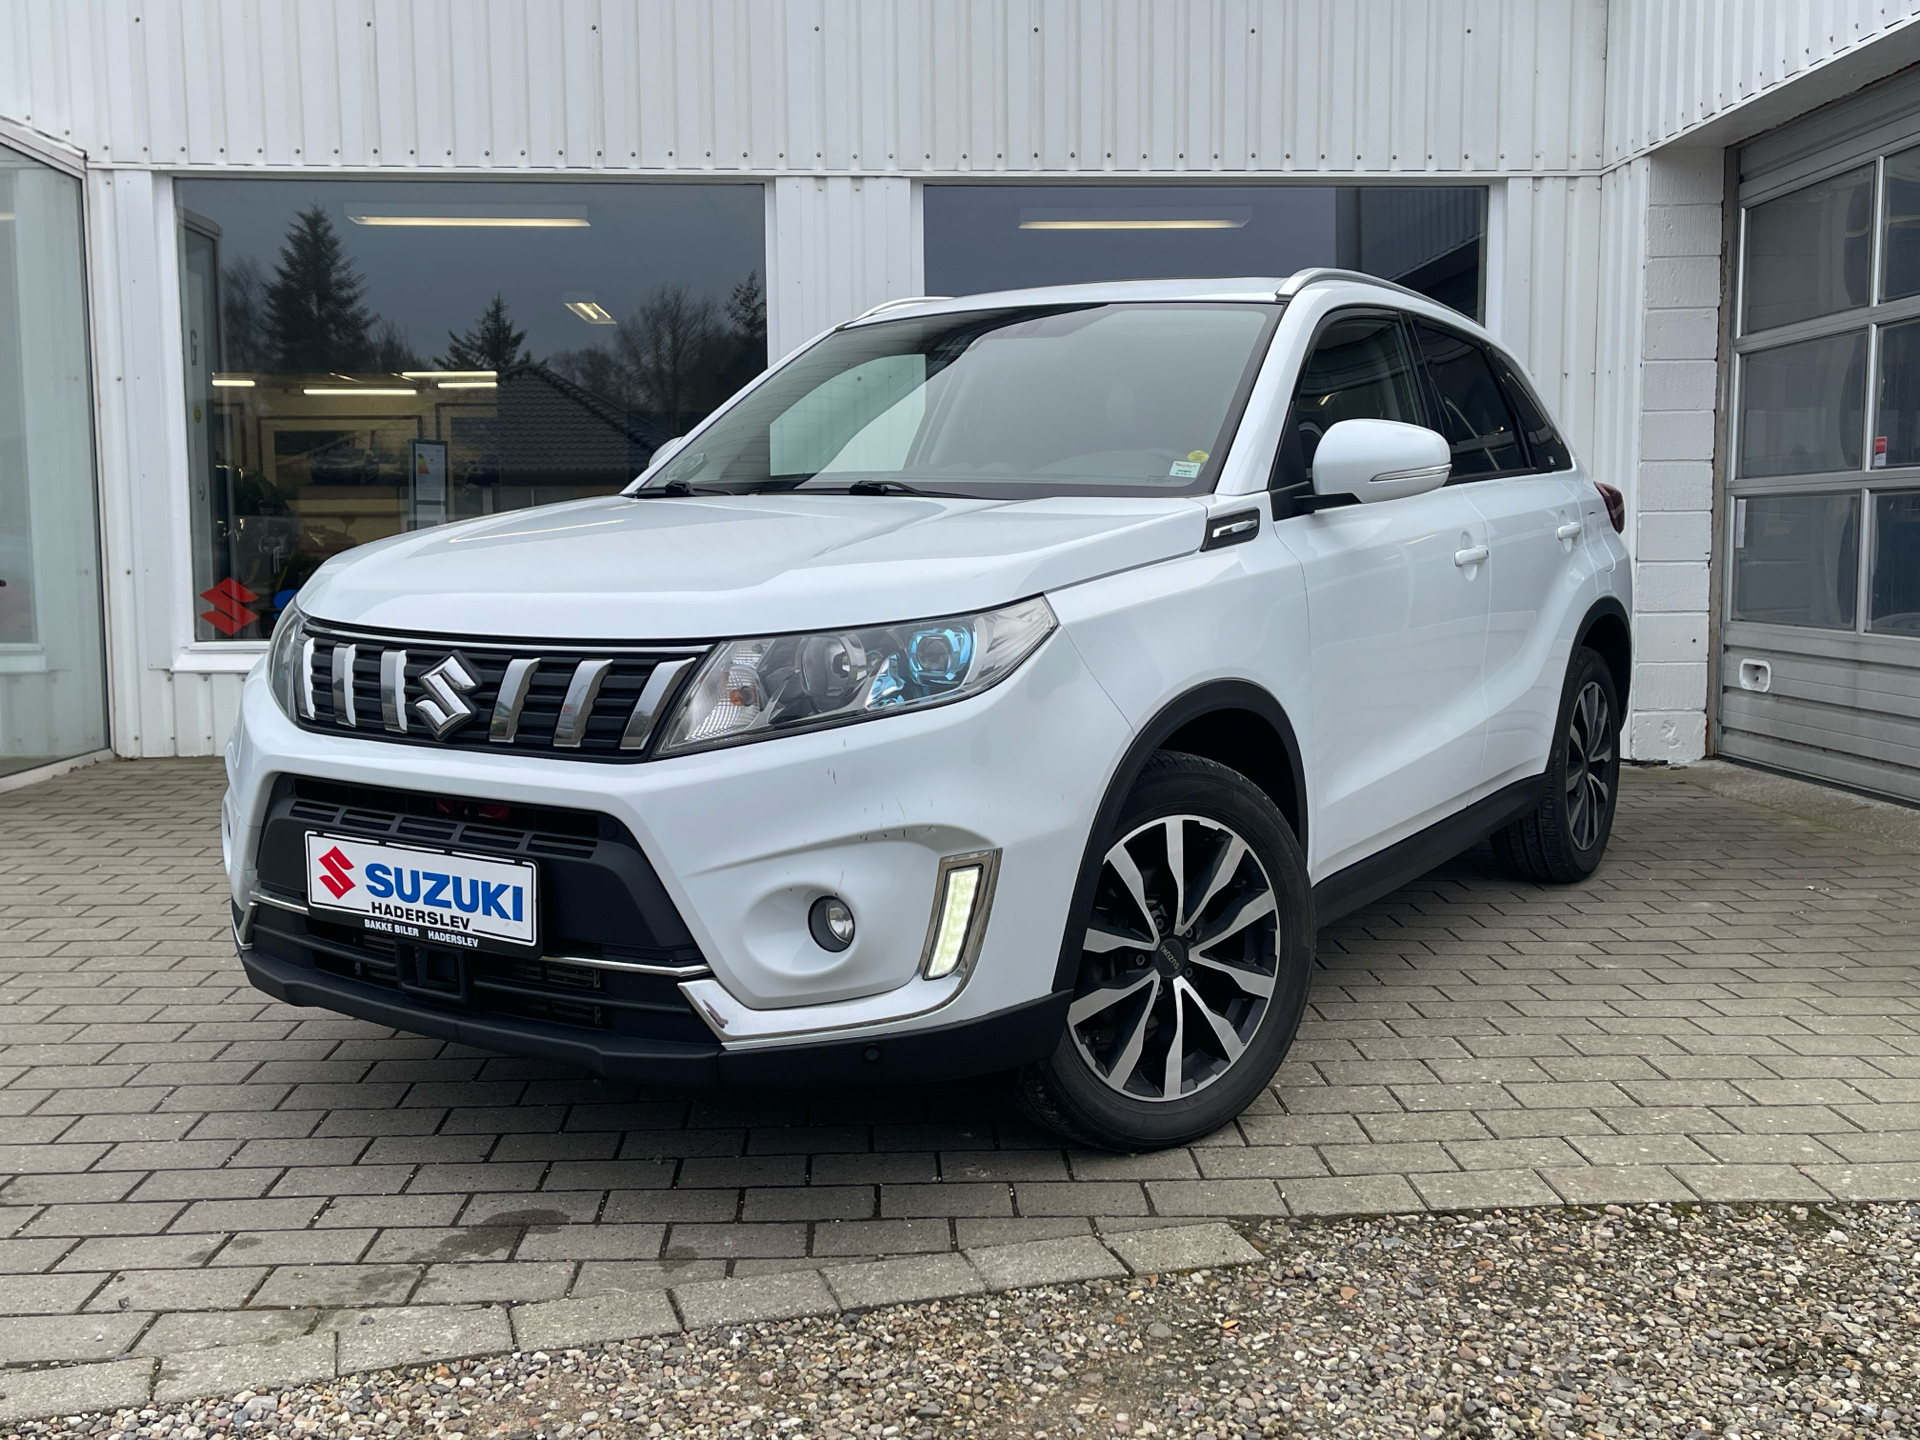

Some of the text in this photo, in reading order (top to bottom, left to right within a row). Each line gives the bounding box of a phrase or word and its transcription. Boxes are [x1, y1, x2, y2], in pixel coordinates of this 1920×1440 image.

[365, 863, 524, 922] SUZUKI
[371, 901, 471, 931] HADERSLEV
[364, 919, 479, 948] BAKKE BILER HADERSLEV
[1160, 944, 1180, 970] SUZUKI
